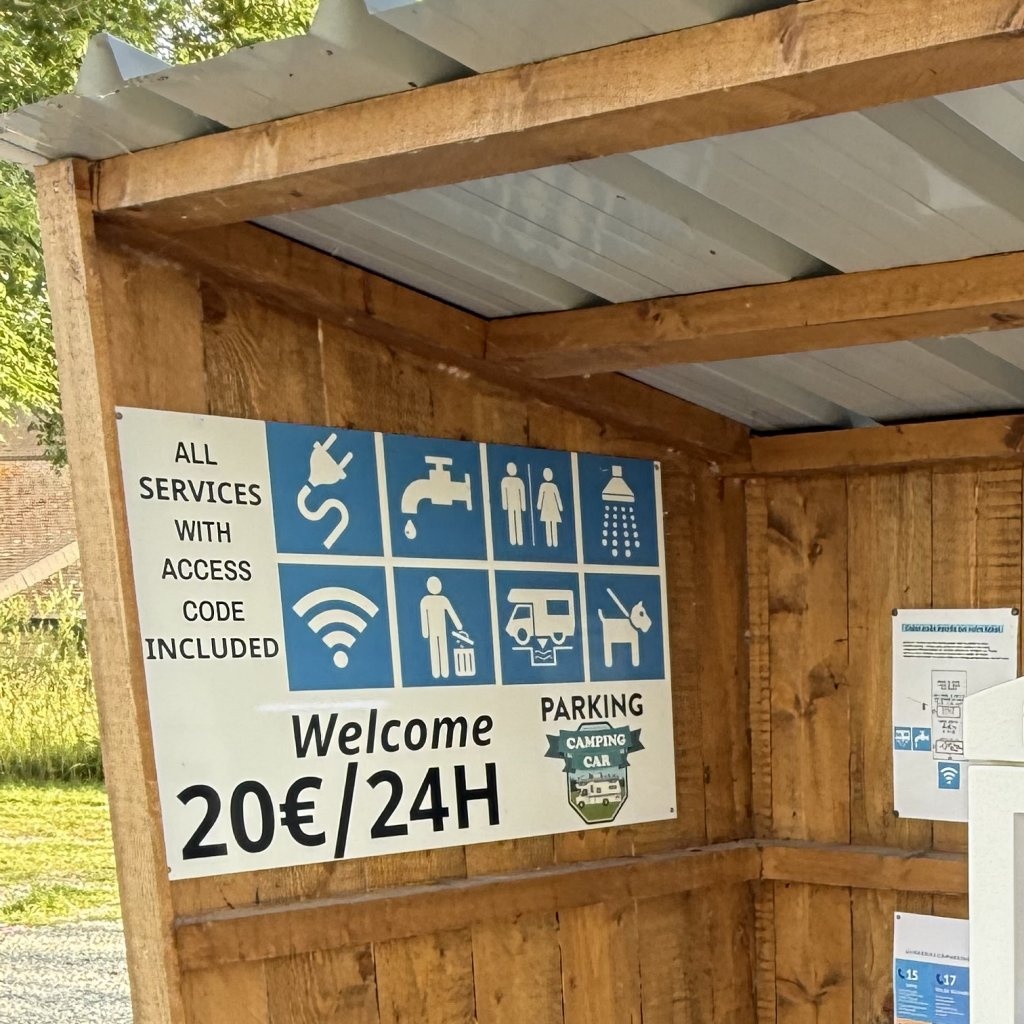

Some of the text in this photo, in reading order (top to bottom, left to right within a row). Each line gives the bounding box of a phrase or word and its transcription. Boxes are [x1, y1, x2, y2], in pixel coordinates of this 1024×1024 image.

[175, 441, 218, 466] ALL
[139, 476, 262, 506] SERVICES
[174, 519, 231, 543] WITH
[161, 558, 252, 582] ACCESS
[182, 600, 245, 622] CODE
[145, 637, 279, 660] INCLUDED
[541, 692, 644, 721] PARKING
[292, 708, 493, 759] Welcome
[566, 734, 626, 750] CAMPING
[583, 754, 611, 768] CAR
[175, 762, 501, 859] 20€/24H
[906, 969, 918, 981] 15
[943, 974, 956, 986] 17
